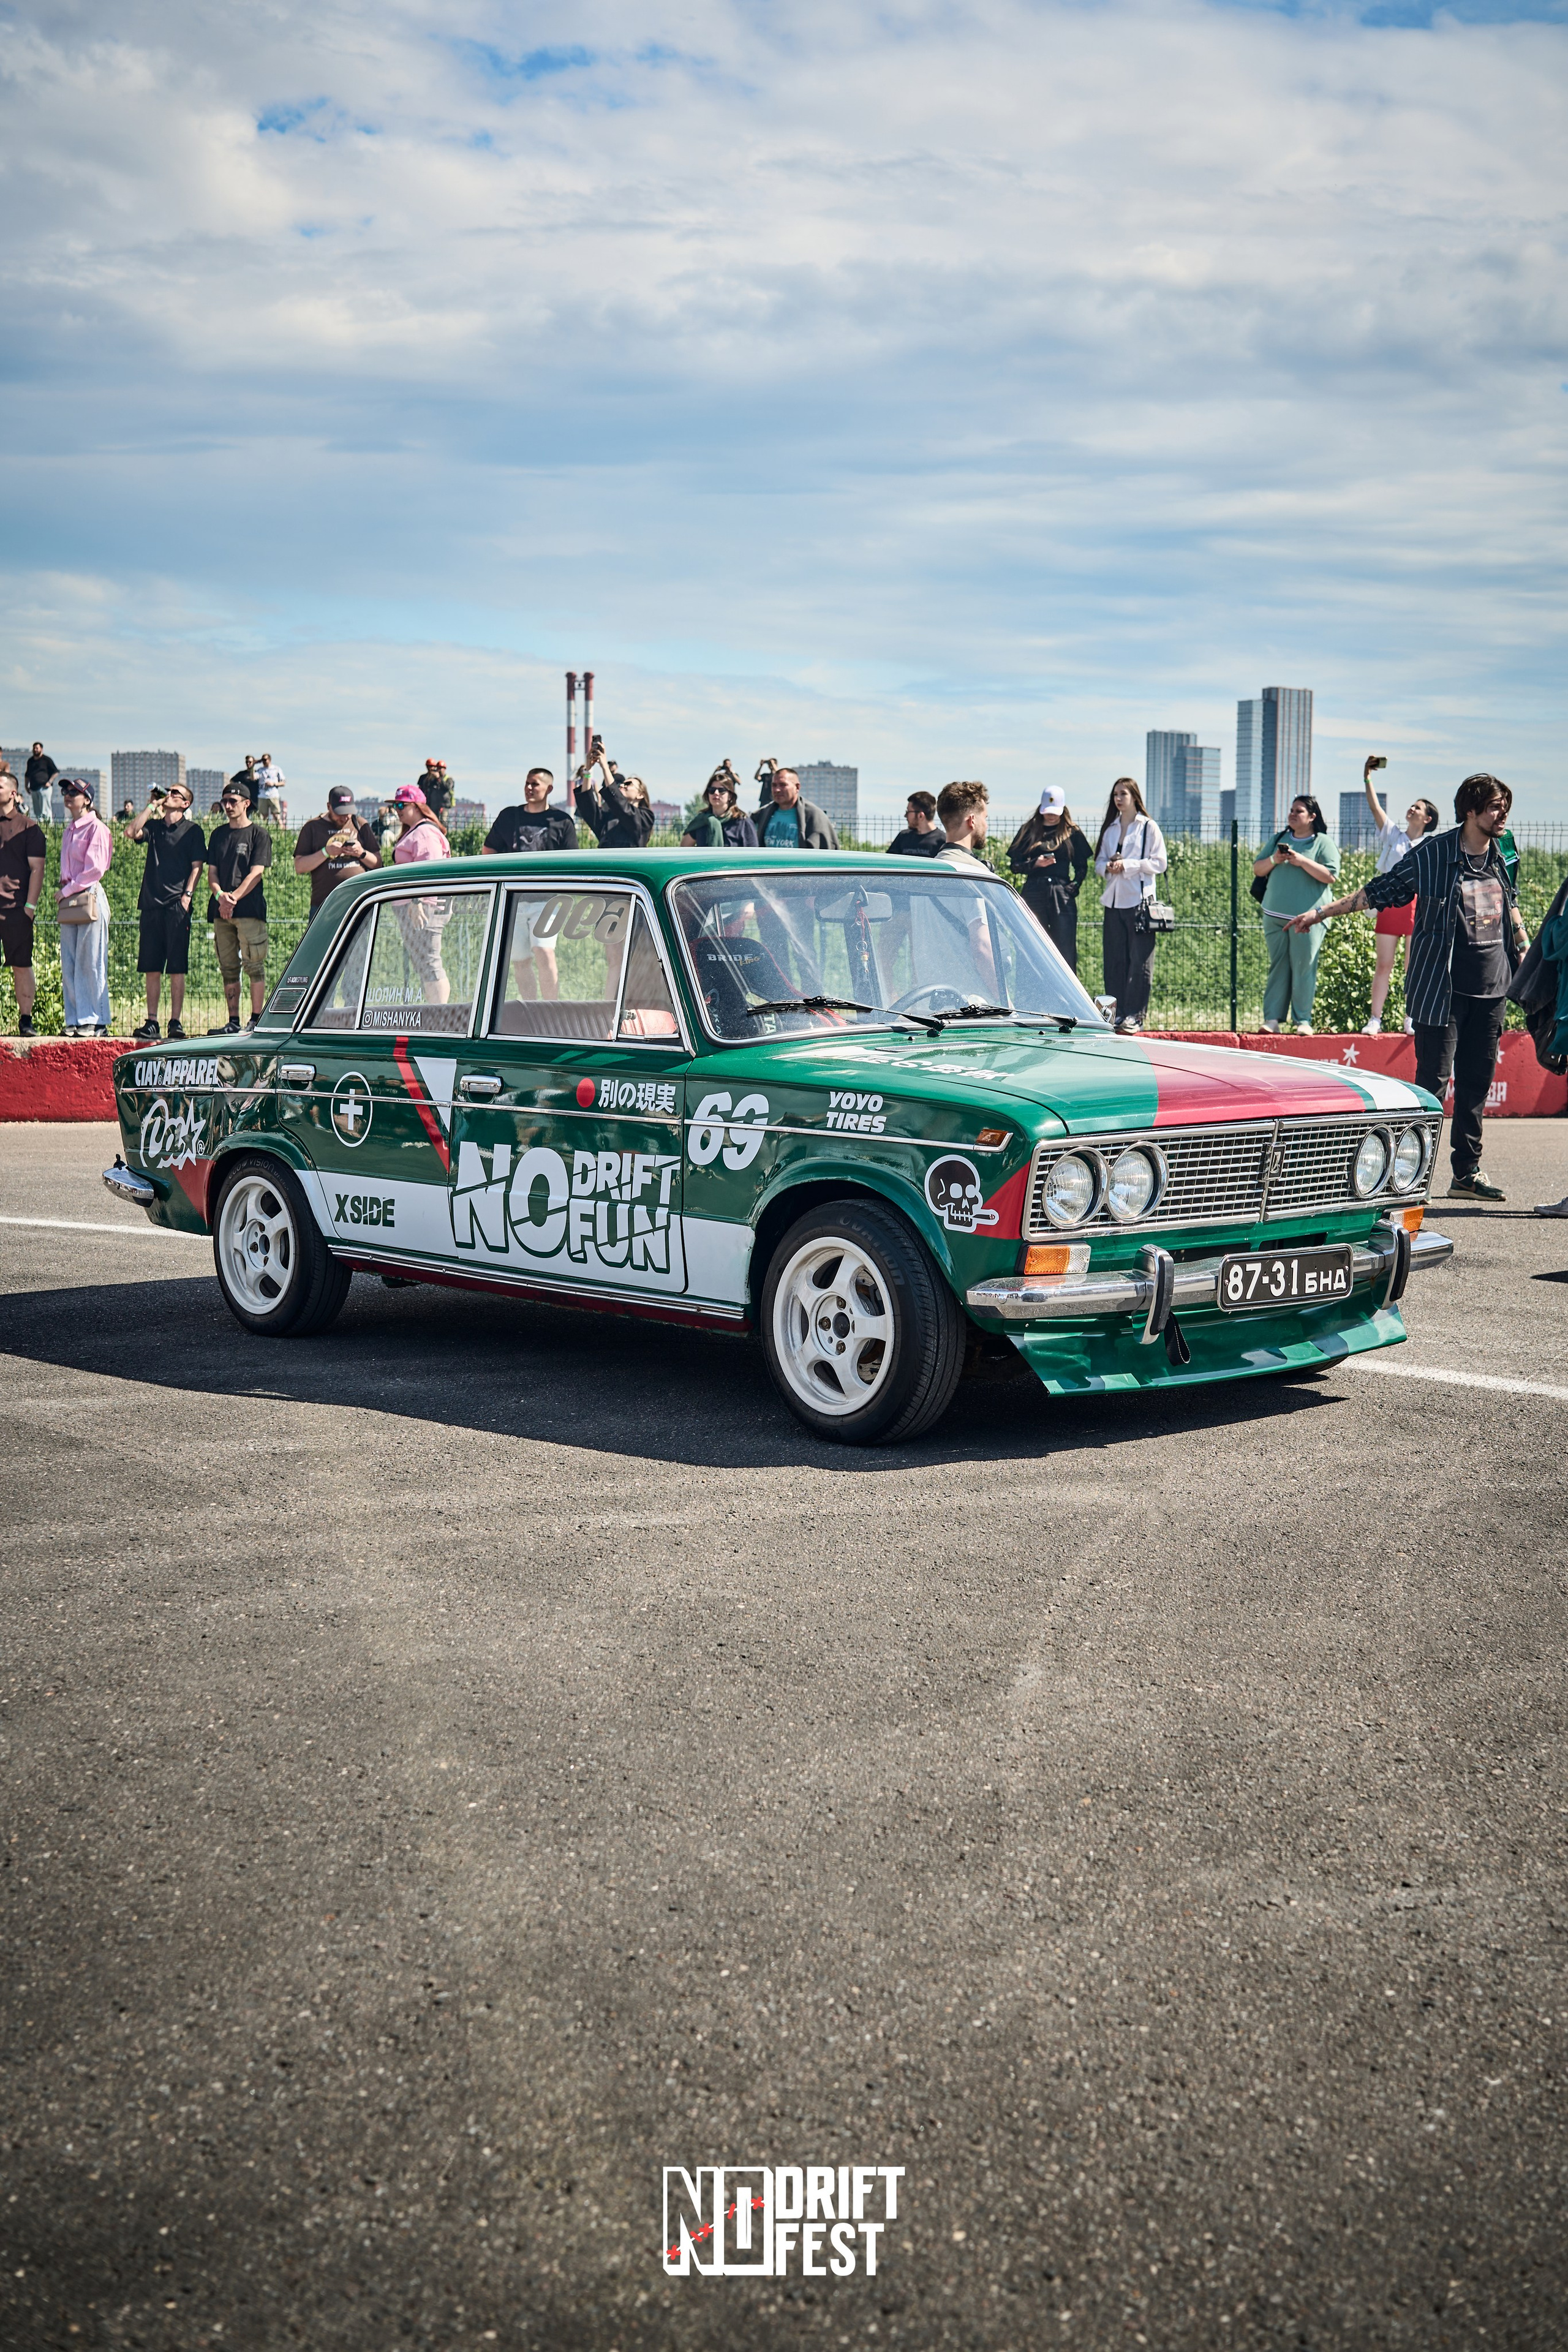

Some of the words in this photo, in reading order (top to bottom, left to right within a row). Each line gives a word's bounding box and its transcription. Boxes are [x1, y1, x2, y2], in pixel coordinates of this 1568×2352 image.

[776, 839, 794, 848] YORK
[372, 1011, 422, 1027] MISHANYKA
[162, 1059, 219, 1085] APPAREL
[598, 1079, 676, 1114] 別の現実
[829, 1091, 883, 1112] YOYO
[687, 1091, 769, 1171] 69
[826, 1111, 887, 1133] TIRES
[334, 1193, 395, 1228] XSIDE
[452, 1140, 570, 1258] NO
[571, 1150, 681, 1205] DRIFT
[568, 1197, 671, 1274] FUN
[1227, 1259, 1299, 1301] 87-31
[1305, 1268, 1347, 1294] БНД
